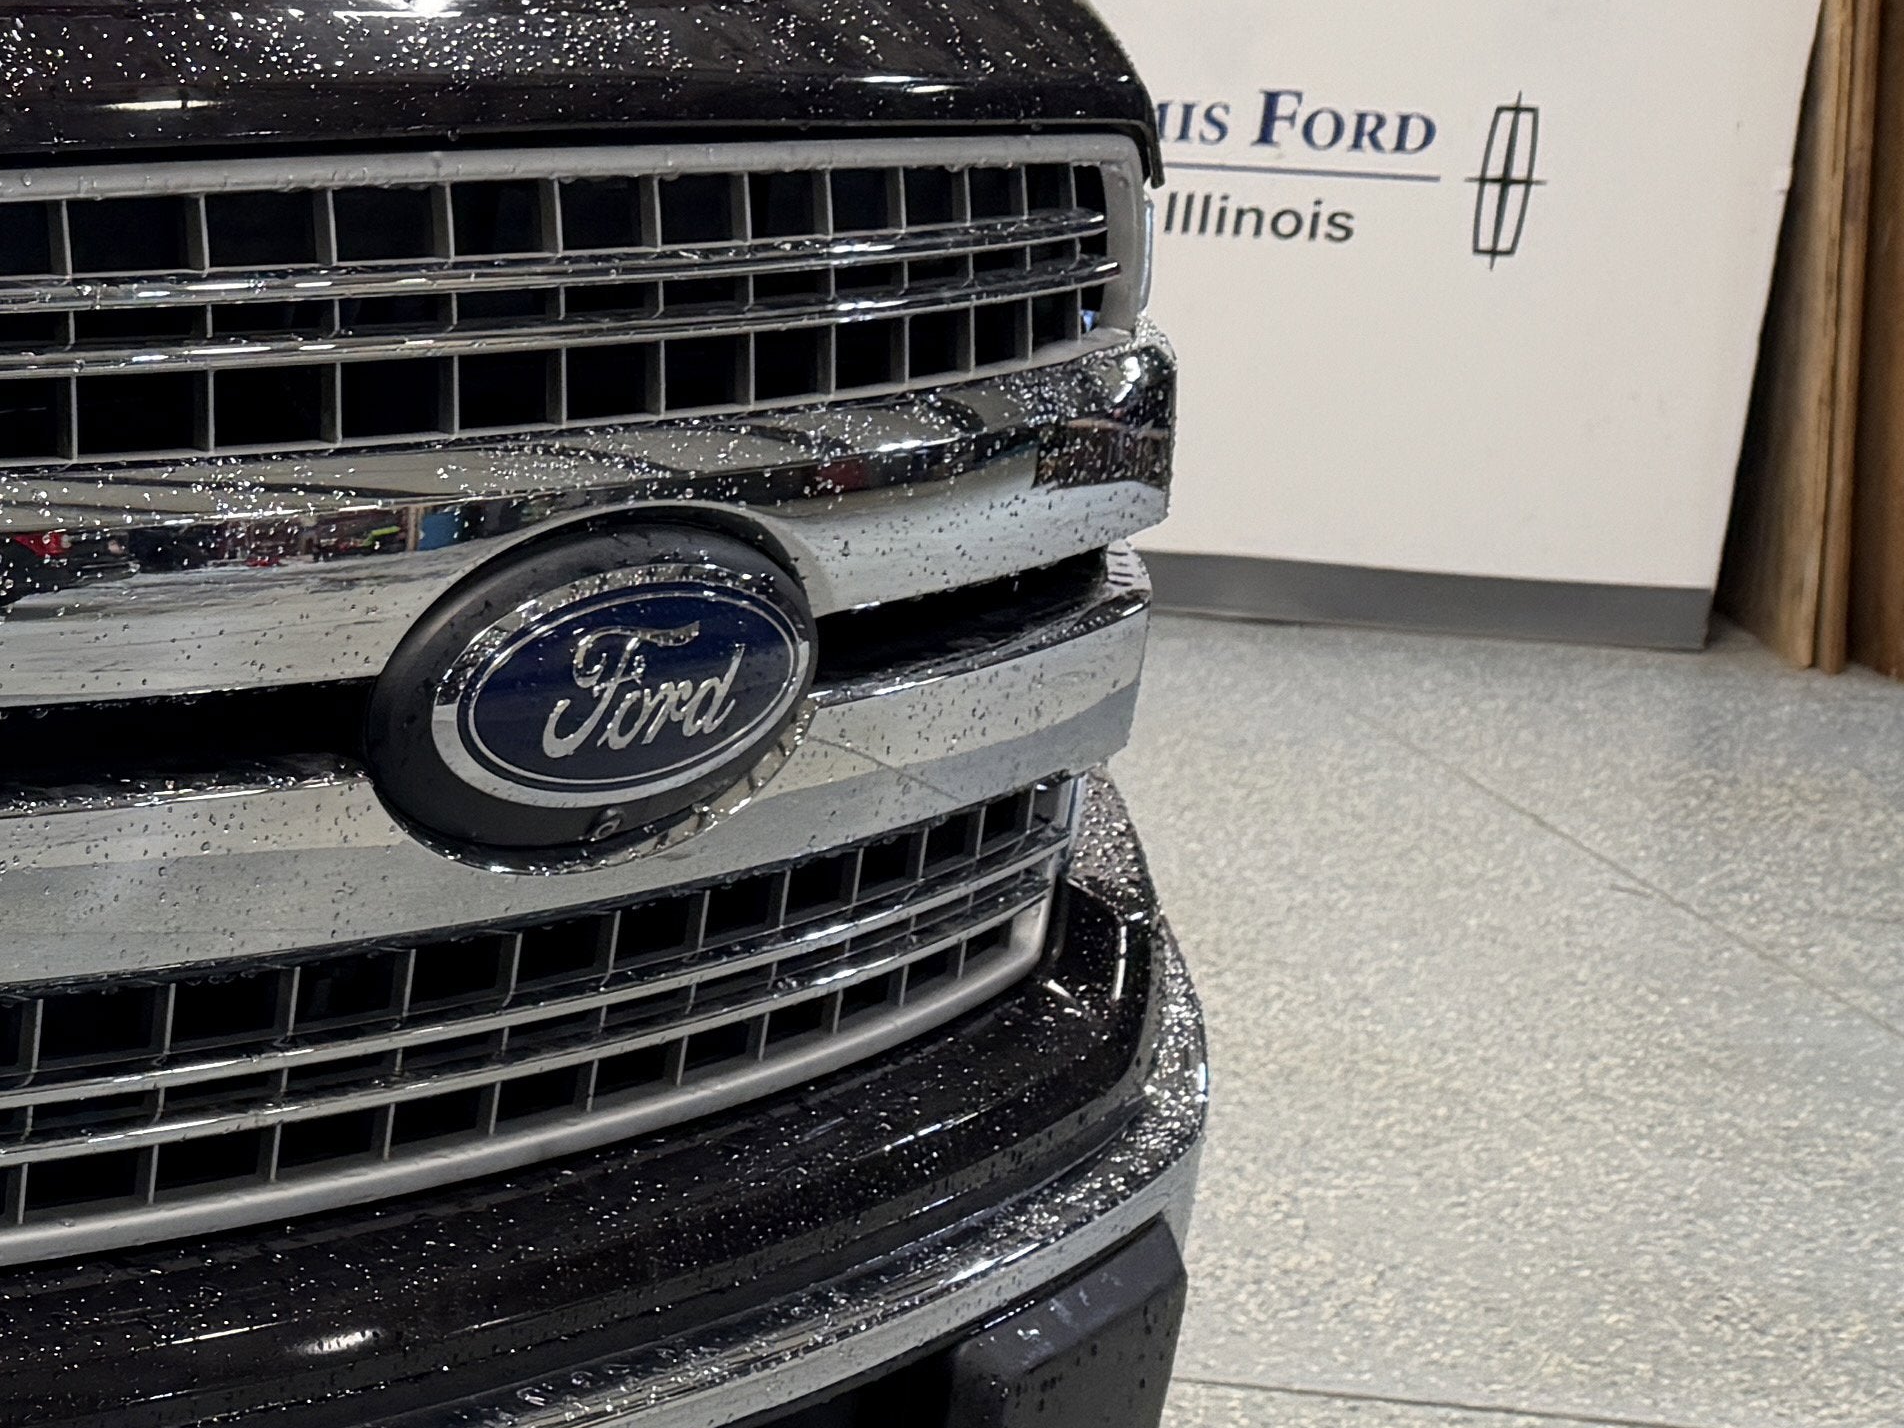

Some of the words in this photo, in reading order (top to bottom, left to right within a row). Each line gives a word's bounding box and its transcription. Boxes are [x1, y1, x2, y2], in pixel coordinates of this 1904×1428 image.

[1251, 88, 1438, 154] FORD
[1163, 190, 1355, 244] Illinois
[542, 620, 747, 758] Ford
